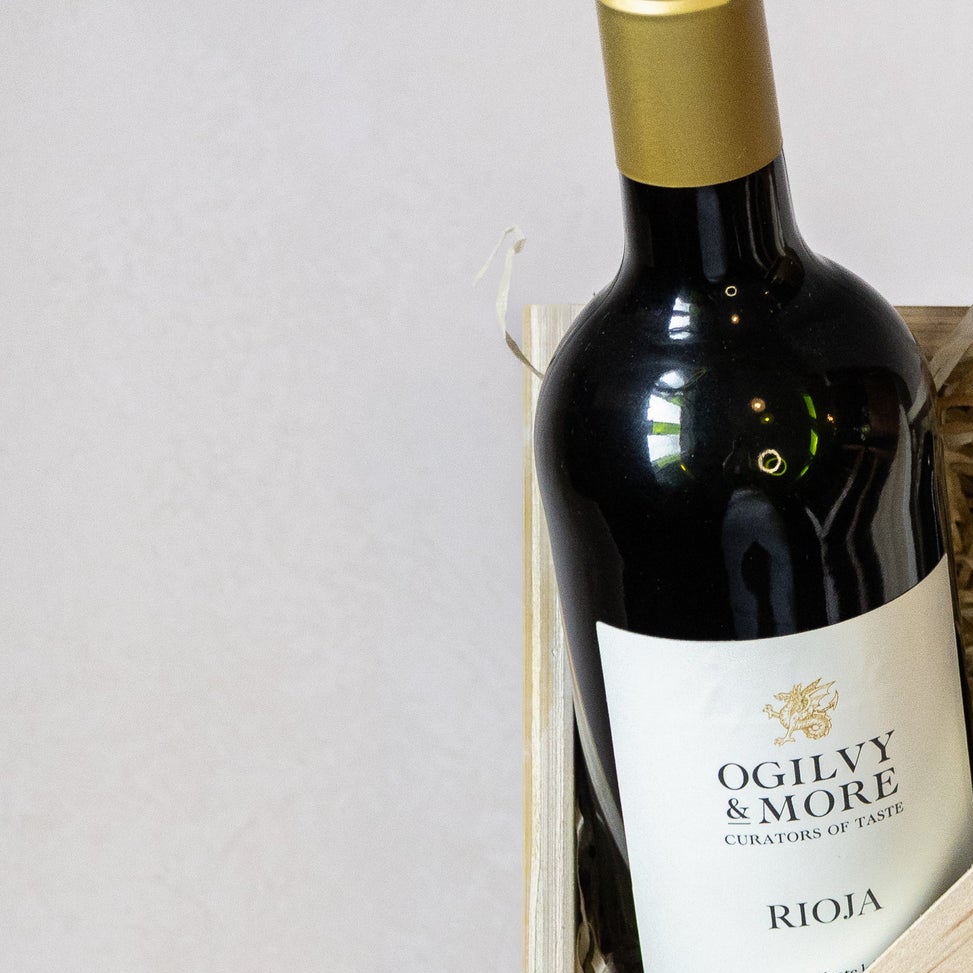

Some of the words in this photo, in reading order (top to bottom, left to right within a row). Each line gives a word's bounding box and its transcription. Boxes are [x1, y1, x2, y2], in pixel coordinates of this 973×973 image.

[717, 729, 895, 791] OGILVY
[726, 797, 751, 821] &
[759, 767, 899, 825] MORE
[724, 827, 822, 846] CURATORS
[827, 821, 849, 836] OF
[855, 801, 904, 829] TASTE
[767, 887, 883, 930] RIOJA
